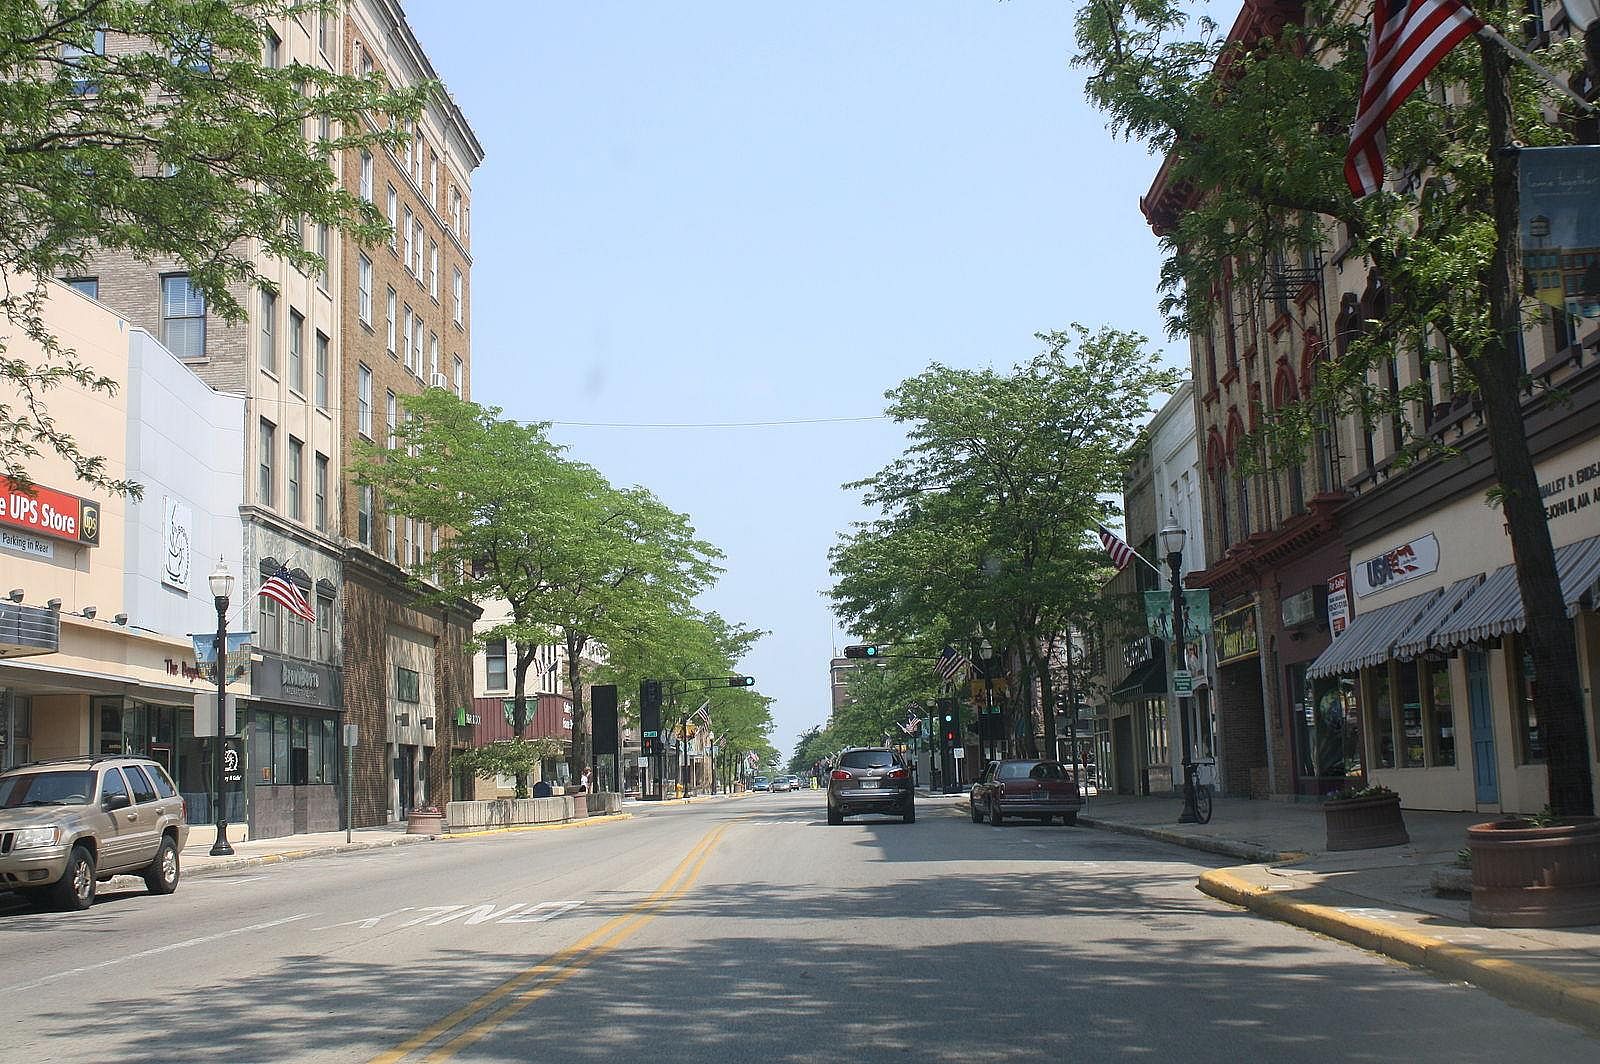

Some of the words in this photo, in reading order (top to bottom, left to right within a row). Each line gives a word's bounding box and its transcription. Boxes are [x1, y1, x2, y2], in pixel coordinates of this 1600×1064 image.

[10, 493, 38, 524] UPS
[41, 503, 75, 534] Store
[84, 516, 97, 533] ups
[2, 532, 27, 551] Parking
[27, 540, 34, 550] in
[35, 541, 49, 553] Rear
[164, 658, 179, 676] The
